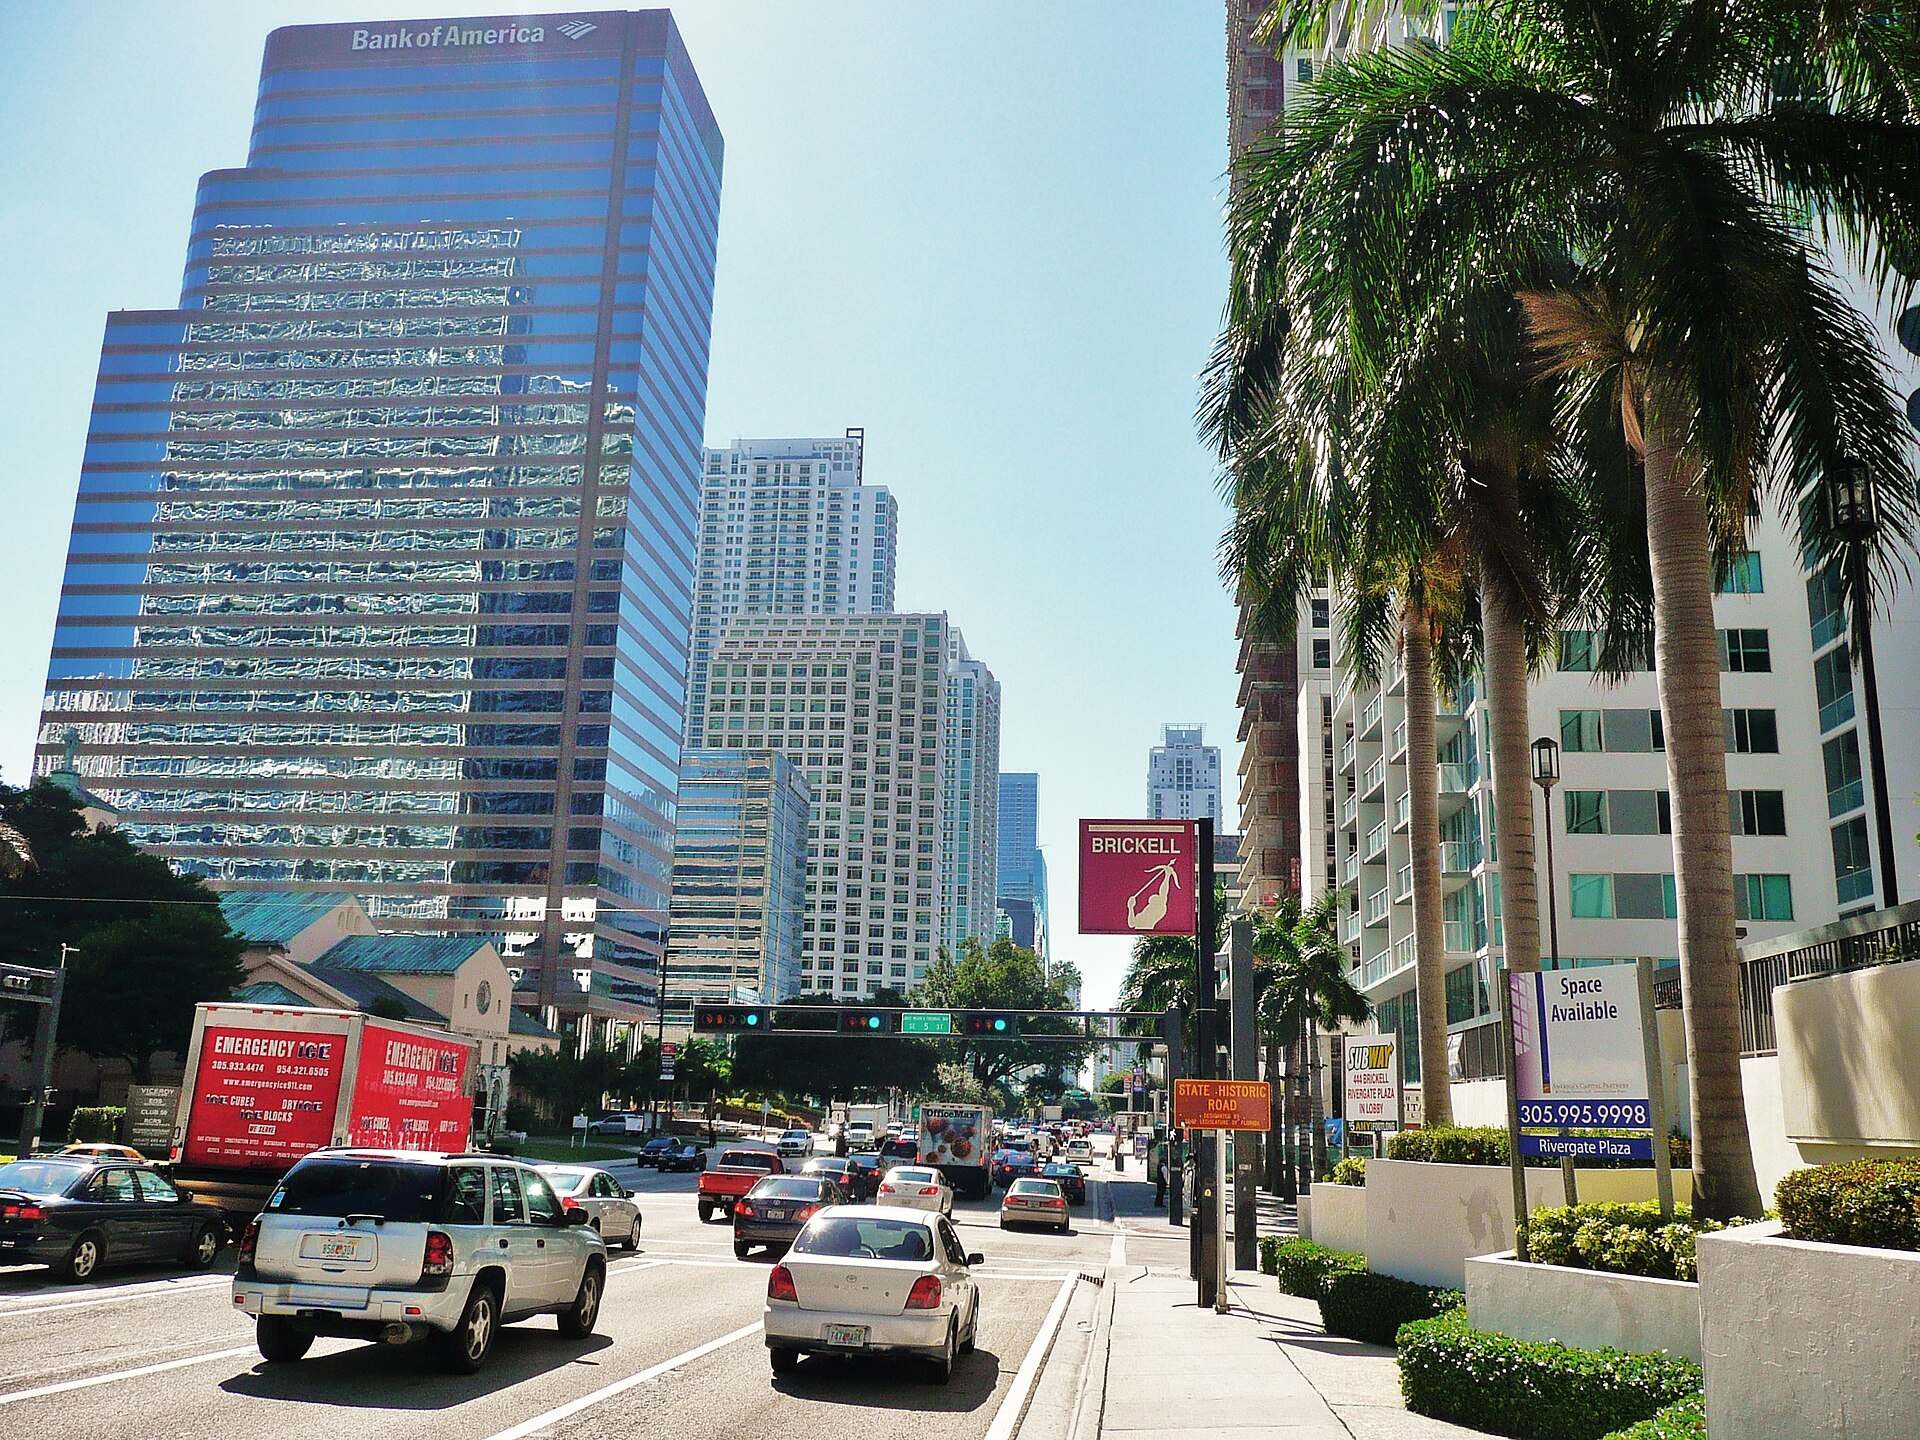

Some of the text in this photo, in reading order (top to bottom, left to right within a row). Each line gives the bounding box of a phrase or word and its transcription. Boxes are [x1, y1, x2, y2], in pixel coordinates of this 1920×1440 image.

[351, 24, 546, 50] Bank of America
[1092, 837, 1181, 854] BRICKELL
[1560, 977, 1602, 999] Space
[1551, 1000, 1618, 1022] Available
[923, 1022, 929, 1031] 5
[214, 1035, 332, 1060] EMERGENCY ICE
[385, 1040, 459, 1074] EMERGENCY ICE
[1347, 1042, 1395, 1071] SUBWAY
[211, 1060, 330, 1077] 305.933.4474 954.321.6505
[223, 1077, 313, 1091] www.emergencyice911.com
[1353, 1073, 1389, 1084] 444 BRICKELL
[140, 1087, 175, 1095] VICEROY
[1179, 1084, 1267, 1098] STATE HISTORIC
[1348, 1087, 1395, 1100] RIVERGATE PLAZA
[230, 1095, 255, 1107] CUBES
[281, 1099, 298, 1110] DRY
[1208, 1099, 1238, 1111] ROAD
[1359, 1102, 1384, 1114] IN LOBBY
[263, 1110, 294, 1122] BLOCKS
[927, 1109, 975, 1119] OfficeMax
[1520, 1105, 1647, 1124] 305.995.9998
[1355, 1121, 1370, 1131] ANY
[1539, 1139, 1631, 1157] Rivergate Plaza
